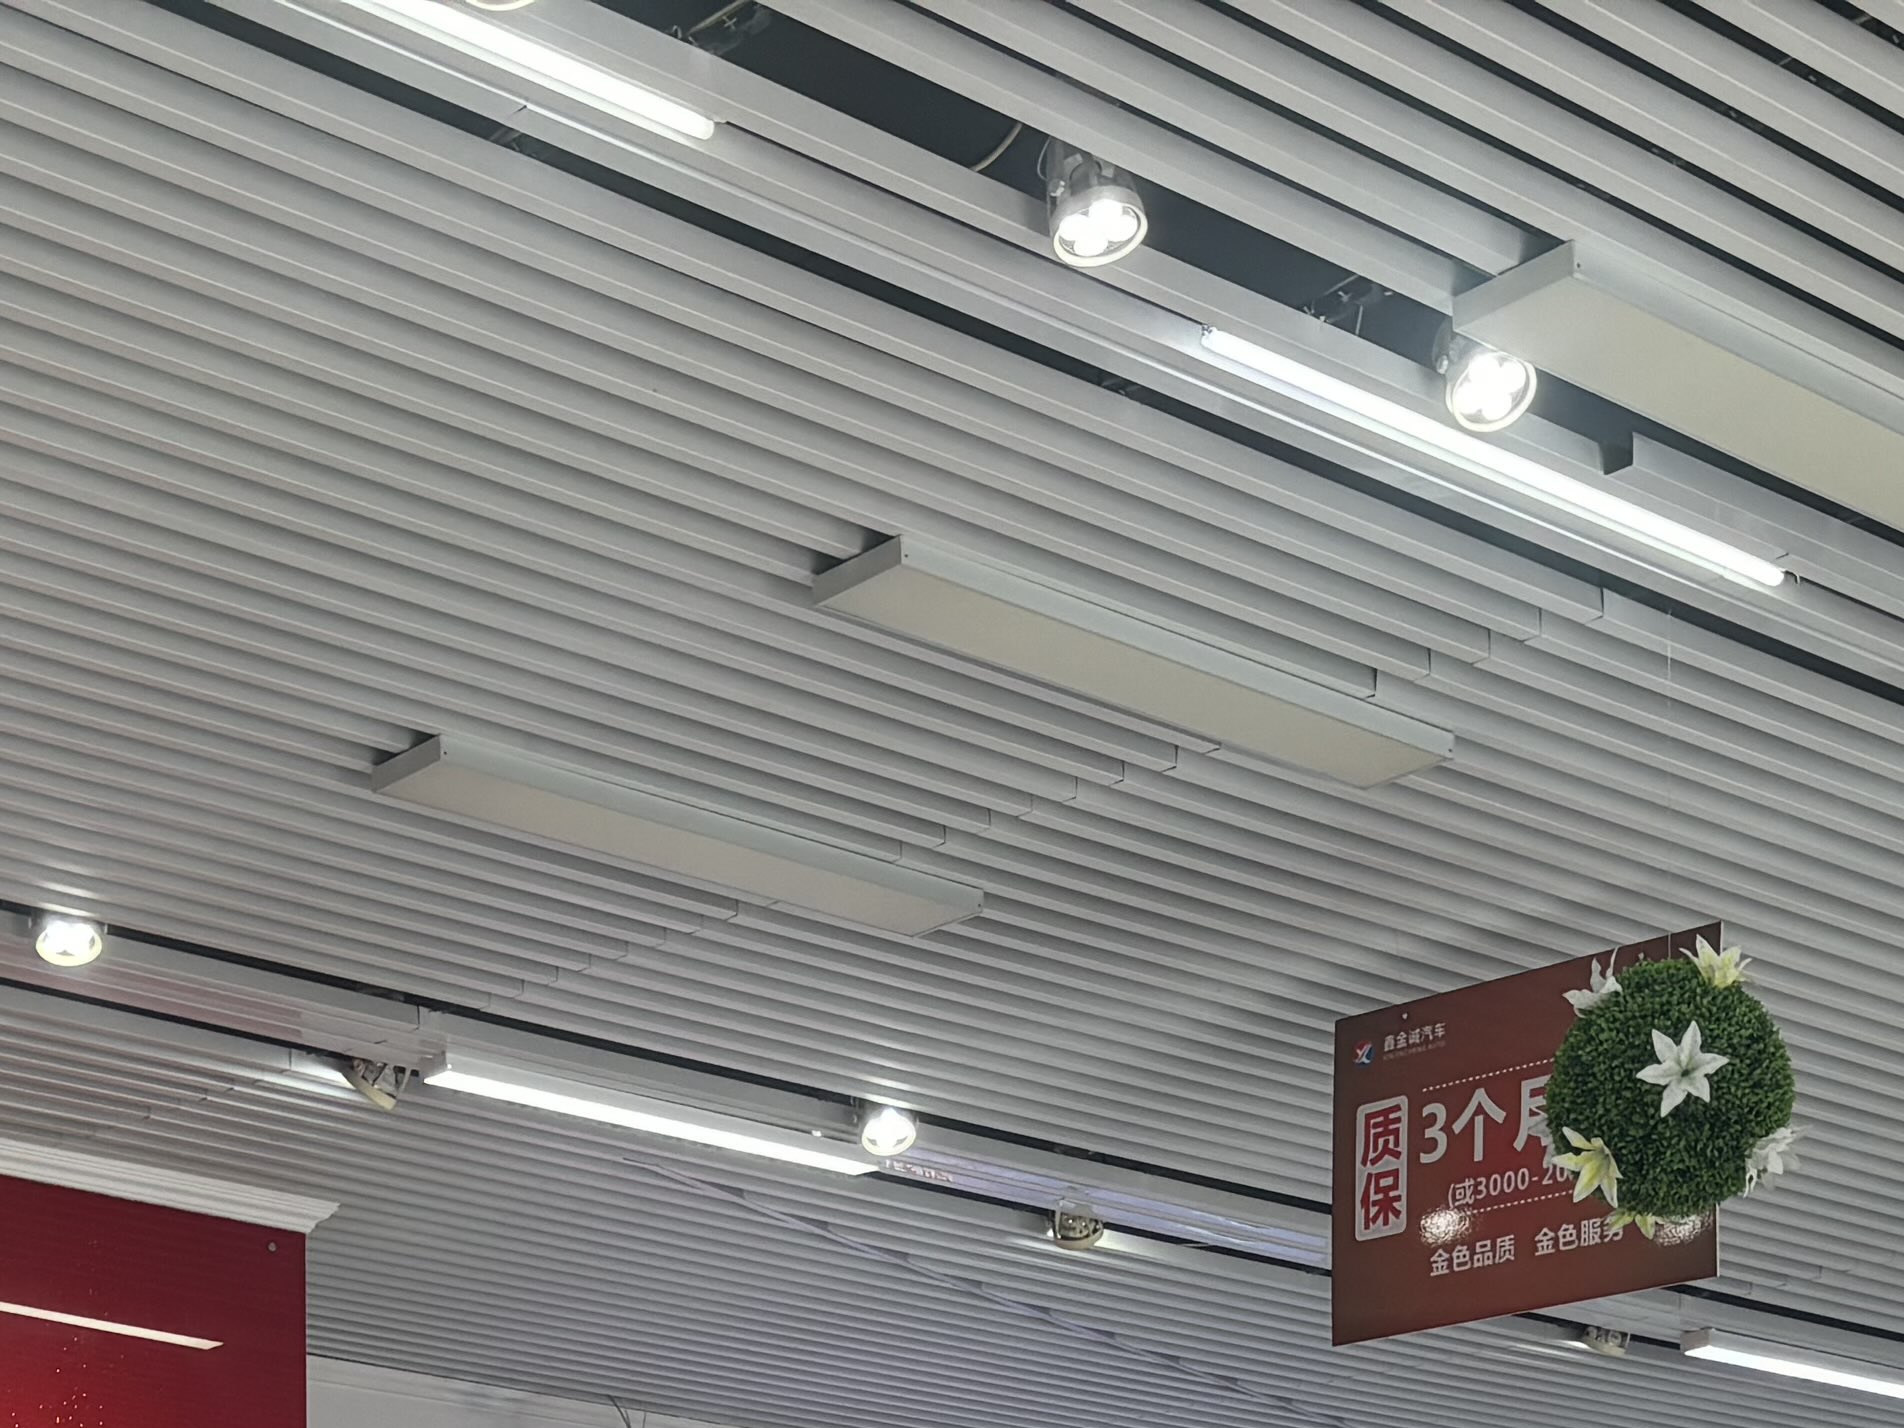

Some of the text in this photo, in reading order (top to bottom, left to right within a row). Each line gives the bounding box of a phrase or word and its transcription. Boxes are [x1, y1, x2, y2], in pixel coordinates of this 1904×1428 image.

[1360, 1103, 1402, 1232] 质保
[1429, 1214, 1624, 1277] 金色品质 金色服务
